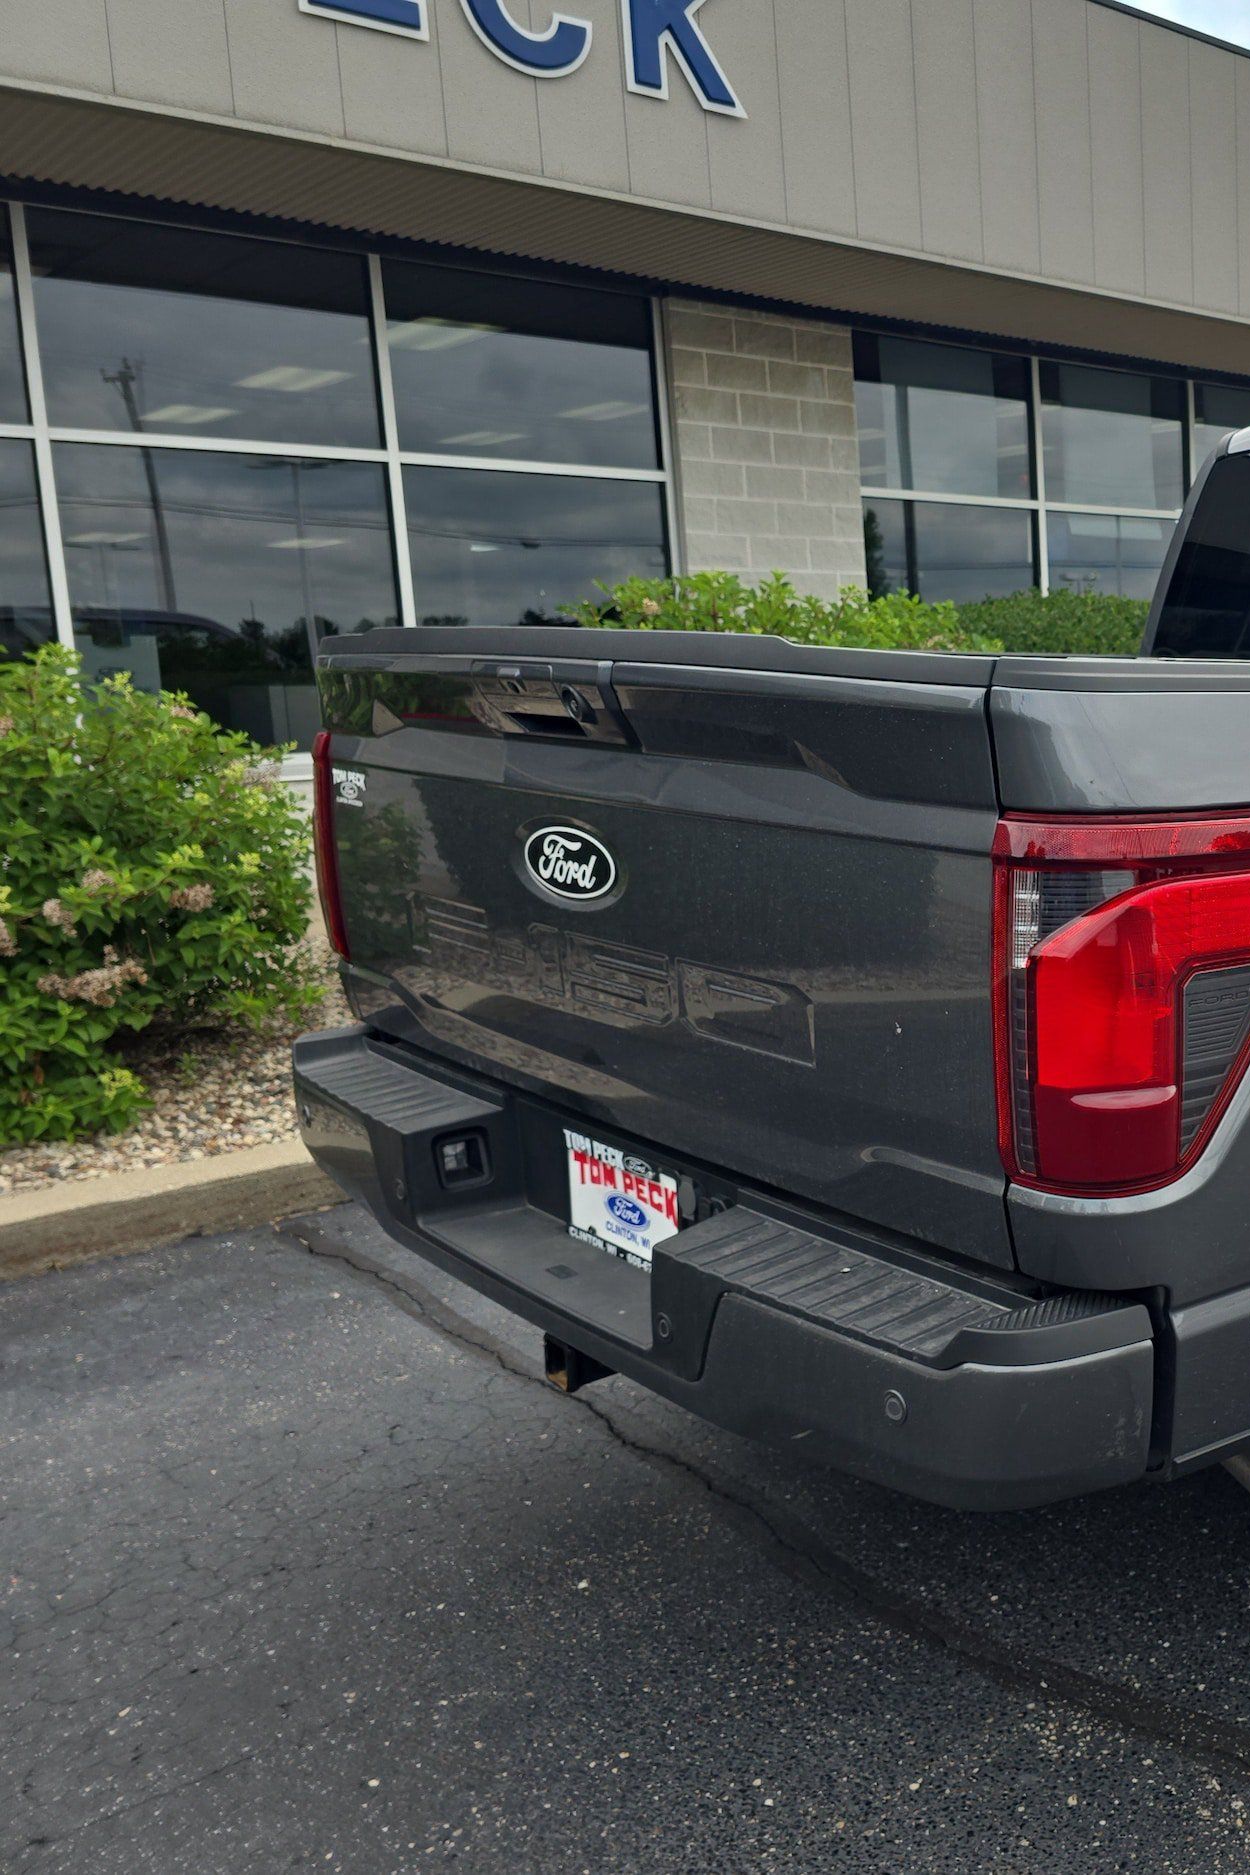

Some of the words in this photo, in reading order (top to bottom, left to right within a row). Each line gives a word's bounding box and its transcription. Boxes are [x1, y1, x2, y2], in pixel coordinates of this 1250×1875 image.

[538, 834, 598, 889] Ford
[592, 1139, 625, 1171] PECK
[574, 1150, 618, 1190] TOM
[621, 1170, 679, 1229] PECK
[612, 1196, 641, 1226] Ford
